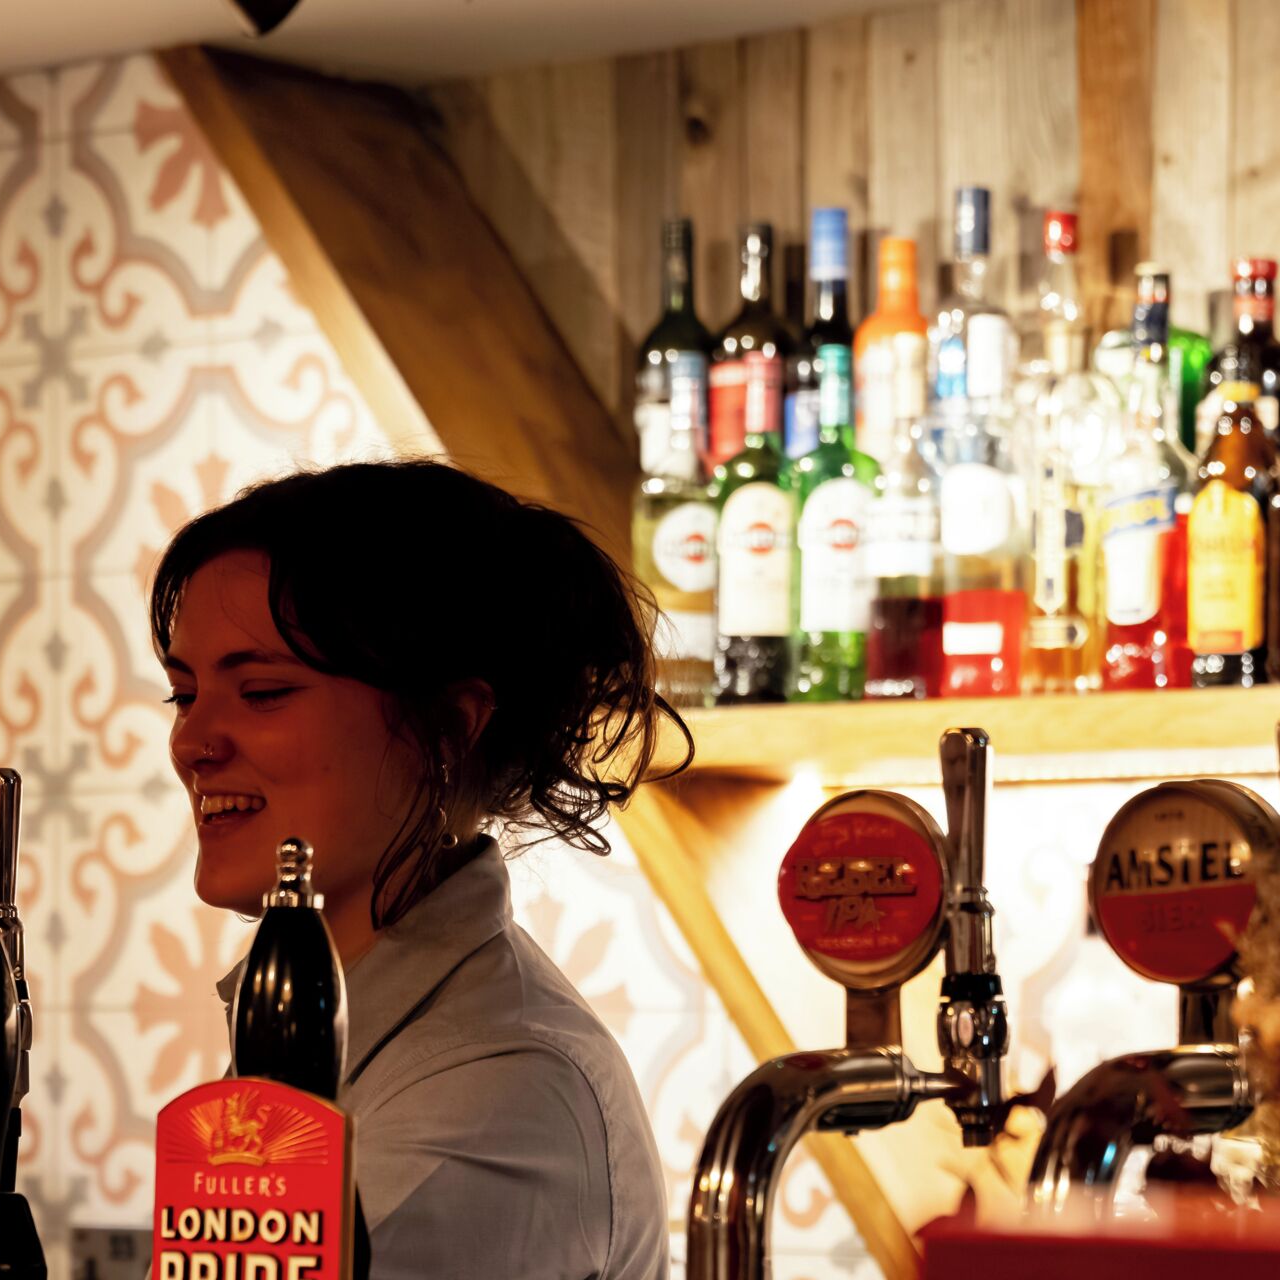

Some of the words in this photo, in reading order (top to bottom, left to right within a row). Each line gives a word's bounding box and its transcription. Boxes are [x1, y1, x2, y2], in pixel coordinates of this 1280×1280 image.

[1105, 842, 1245, 890] AMSTEL
[193, 1171, 288, 1197] FULLER'S
[160, 1206, 322, 1245] LONDON
